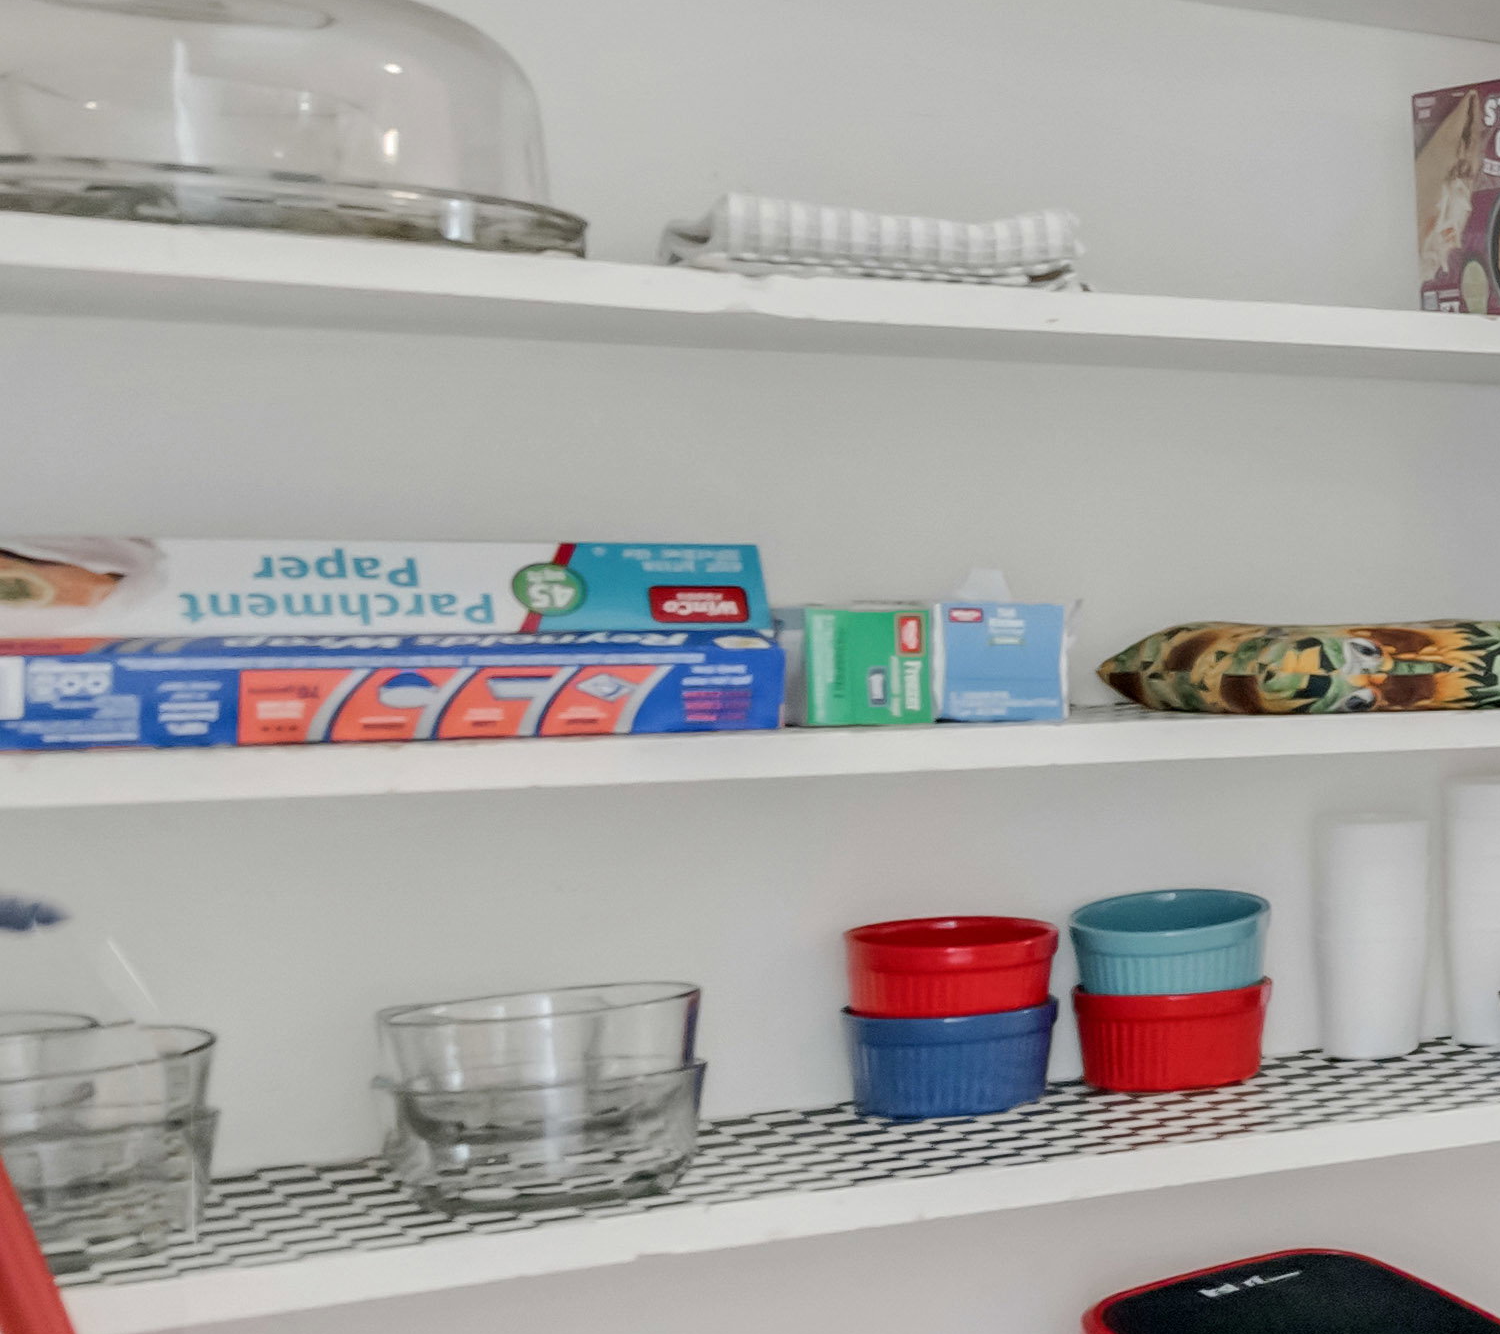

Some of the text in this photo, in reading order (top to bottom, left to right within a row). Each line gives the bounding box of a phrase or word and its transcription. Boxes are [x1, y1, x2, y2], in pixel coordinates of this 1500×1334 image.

[253, 548, 420, 589] Paper
[179, 589, 495, 624] Parchment
[528, 583, 576, 609] 45
[661, 600, 739, 617] WinCo
[415, 631, 690, 648] Reynolds
